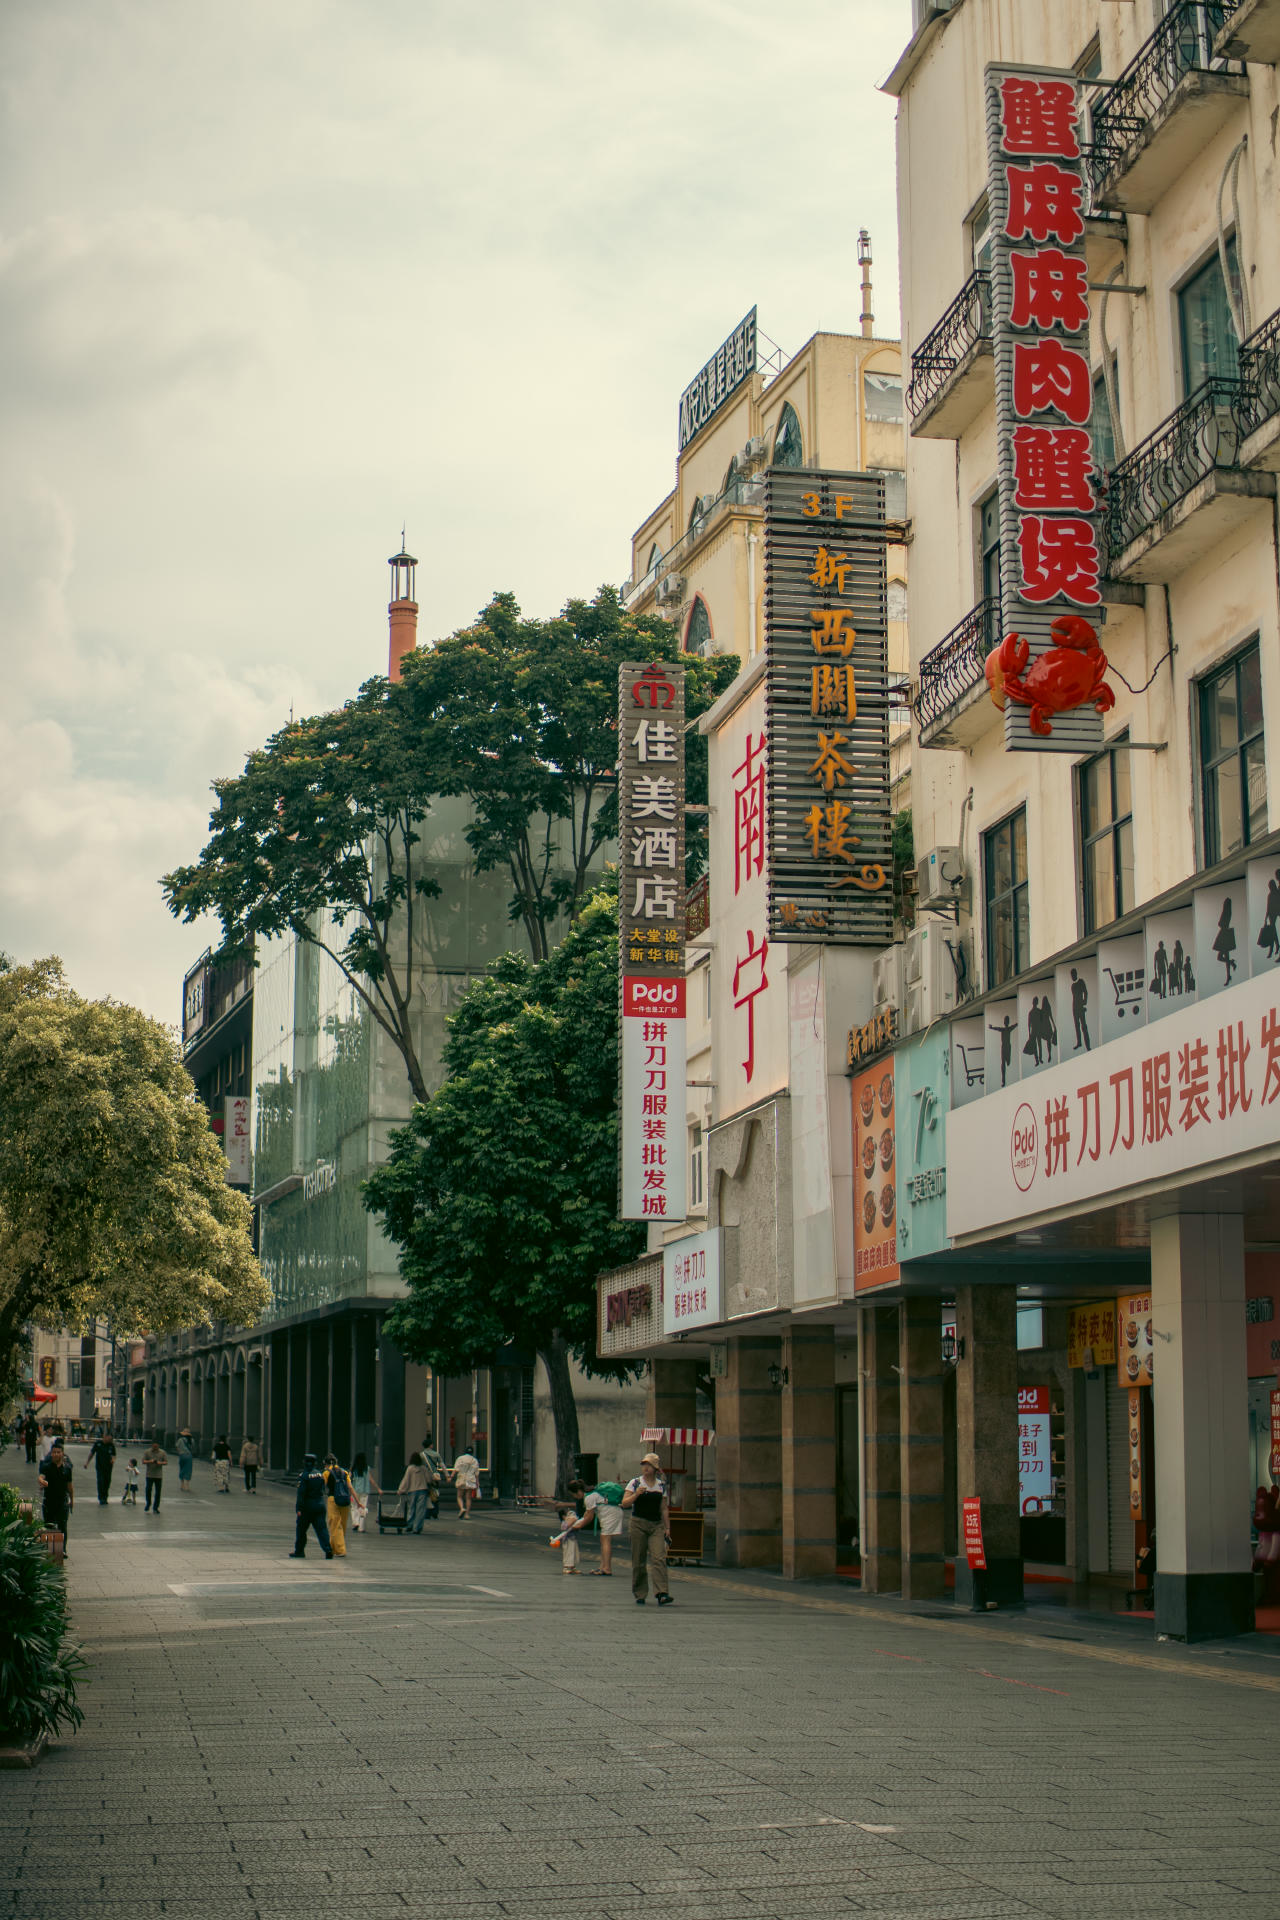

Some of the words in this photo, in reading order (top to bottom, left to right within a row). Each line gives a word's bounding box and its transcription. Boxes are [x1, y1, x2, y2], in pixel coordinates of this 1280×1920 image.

[1000, 77, 1102, 606] 蟹麻麻肉蟹煲
[803, 493, 853, 519] 3F
[804, 546, 862, 865] 新西關茶樓
[631, 719, 679, 919] 佳美酒店
[629, 928, 679, 943] 大堂设
[629, 947, 680, 963] 新华街
[632, 983, 678, 1003] Pdd
[641, 1021, 668, 1216] 拼刀刀服装批发城
[1014, 1124, 1035, 1157] Pdd
[684, 1251, 706, 1284] 拼刀刀
[675, 1287, 707, 1318] 服装批发城
[1022, 1441, 1037, 1456] 到
